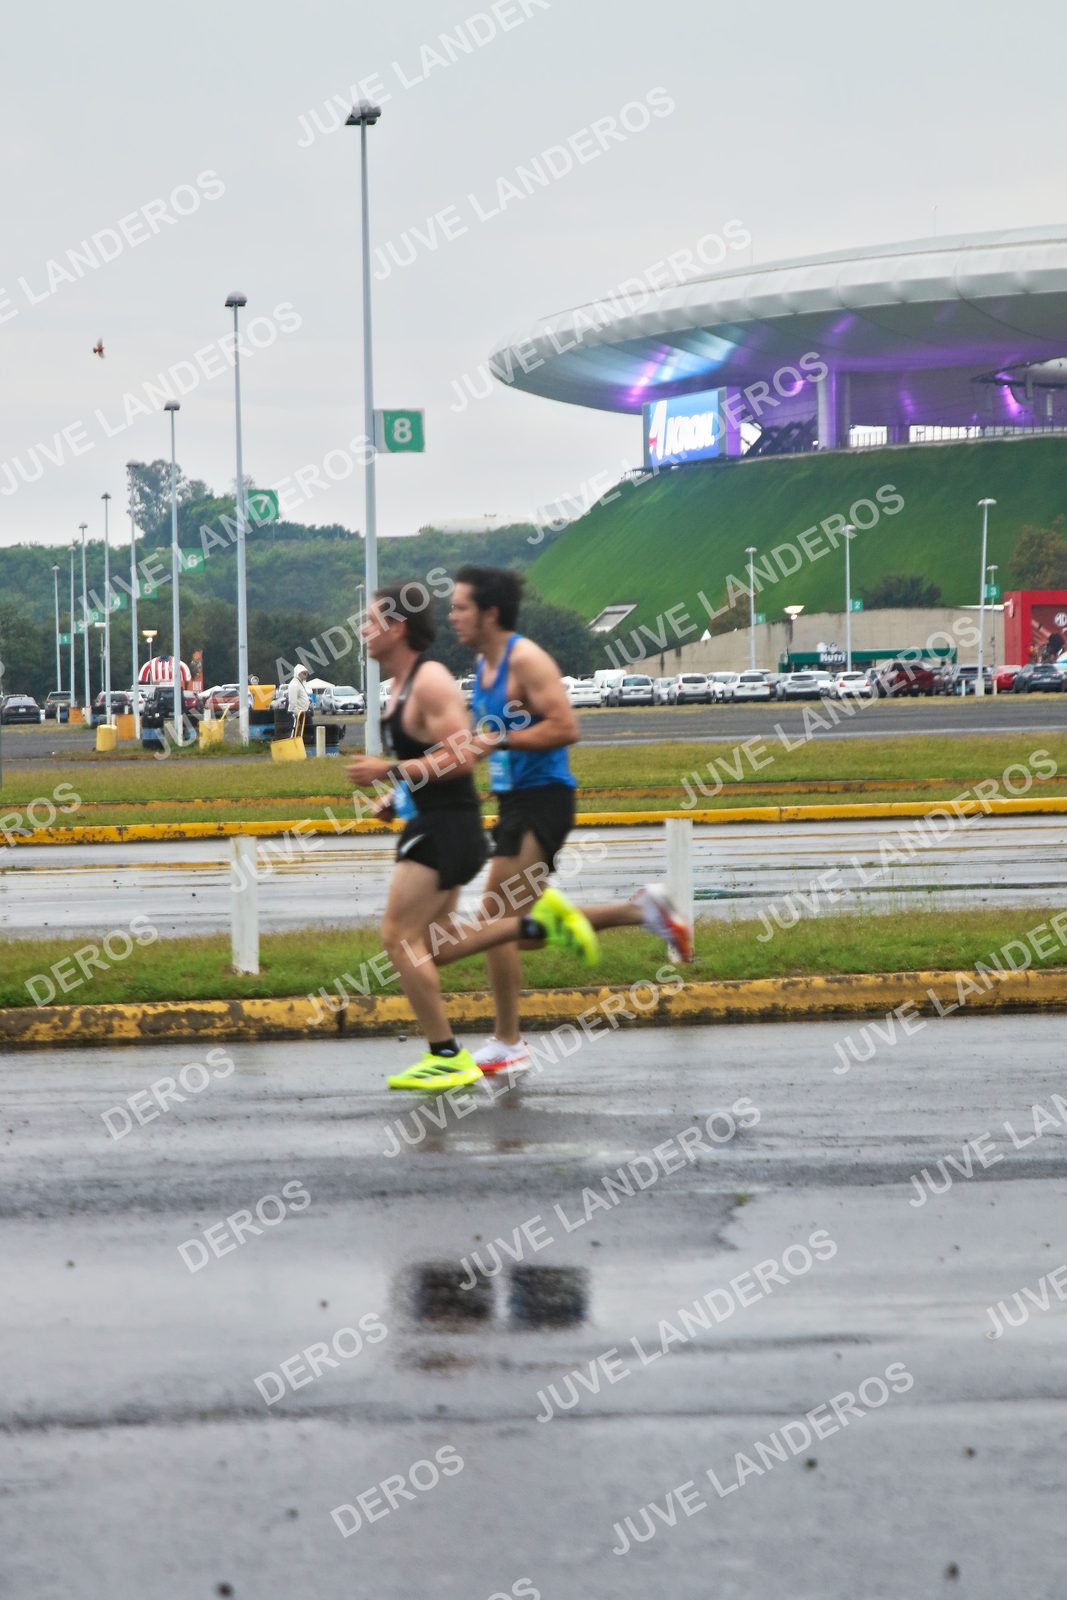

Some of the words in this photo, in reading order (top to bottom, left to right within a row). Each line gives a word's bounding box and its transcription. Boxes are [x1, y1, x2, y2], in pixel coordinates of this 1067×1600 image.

[393, 417, 413, 443] 8
[187, 554, 198, 567] 6
[819, 652, 847, 664] Nutri
